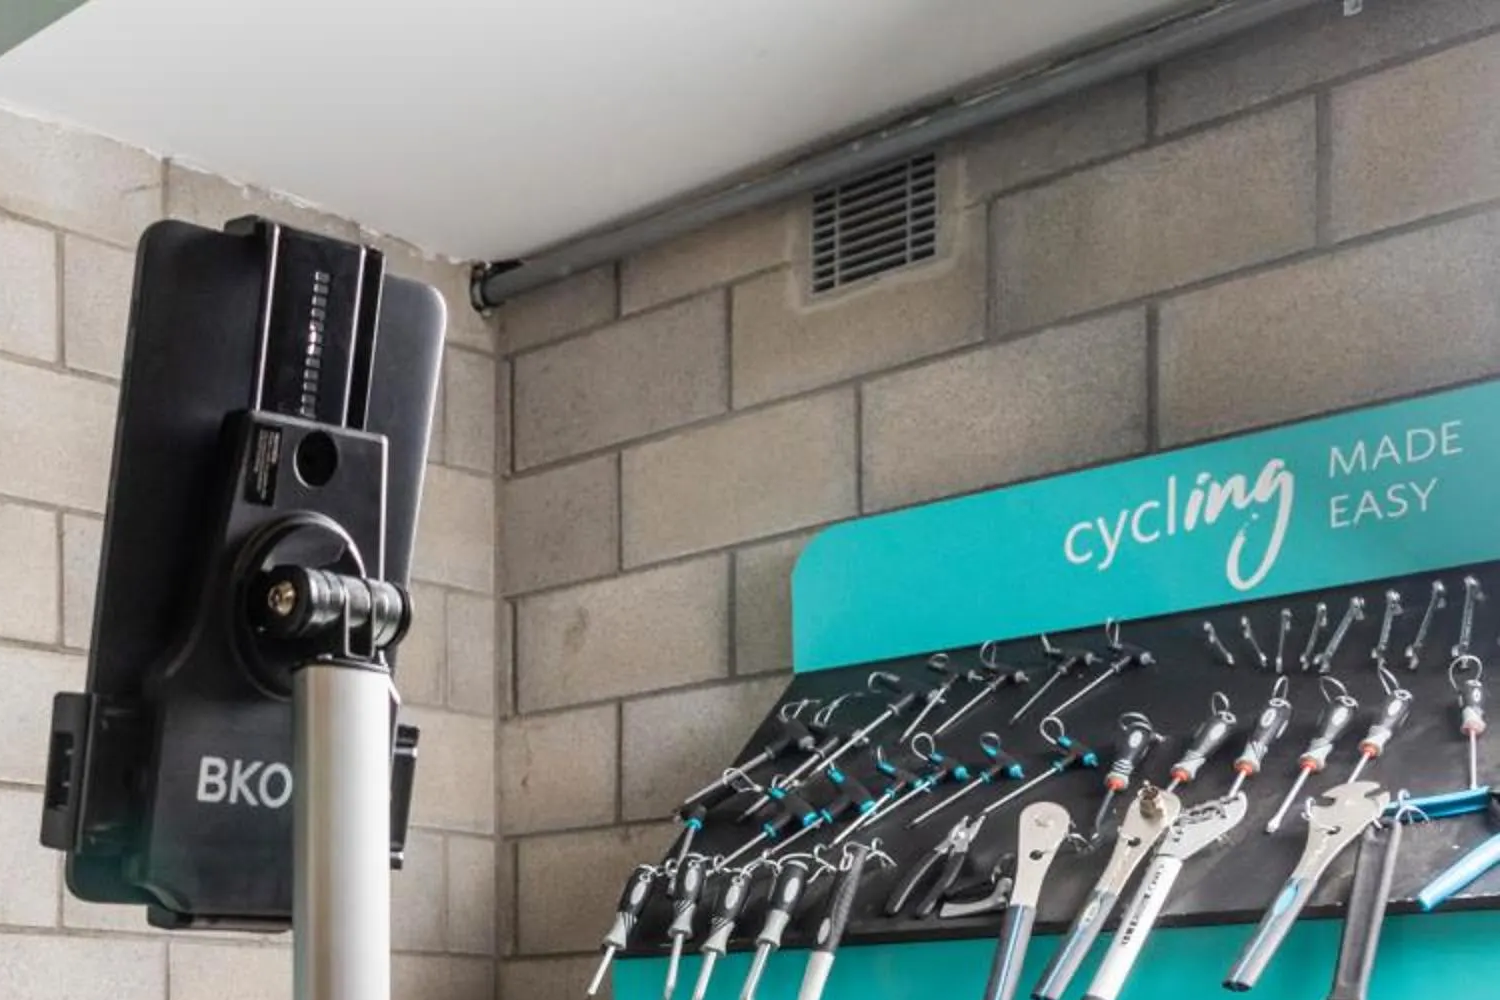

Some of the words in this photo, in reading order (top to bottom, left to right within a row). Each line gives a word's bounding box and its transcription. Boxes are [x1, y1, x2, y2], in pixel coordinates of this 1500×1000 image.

[1328, 419, 1464, 479] MADE
[1062, 457, 1296, 592] cycling
[1329, 477, 1439, 529] EASY
